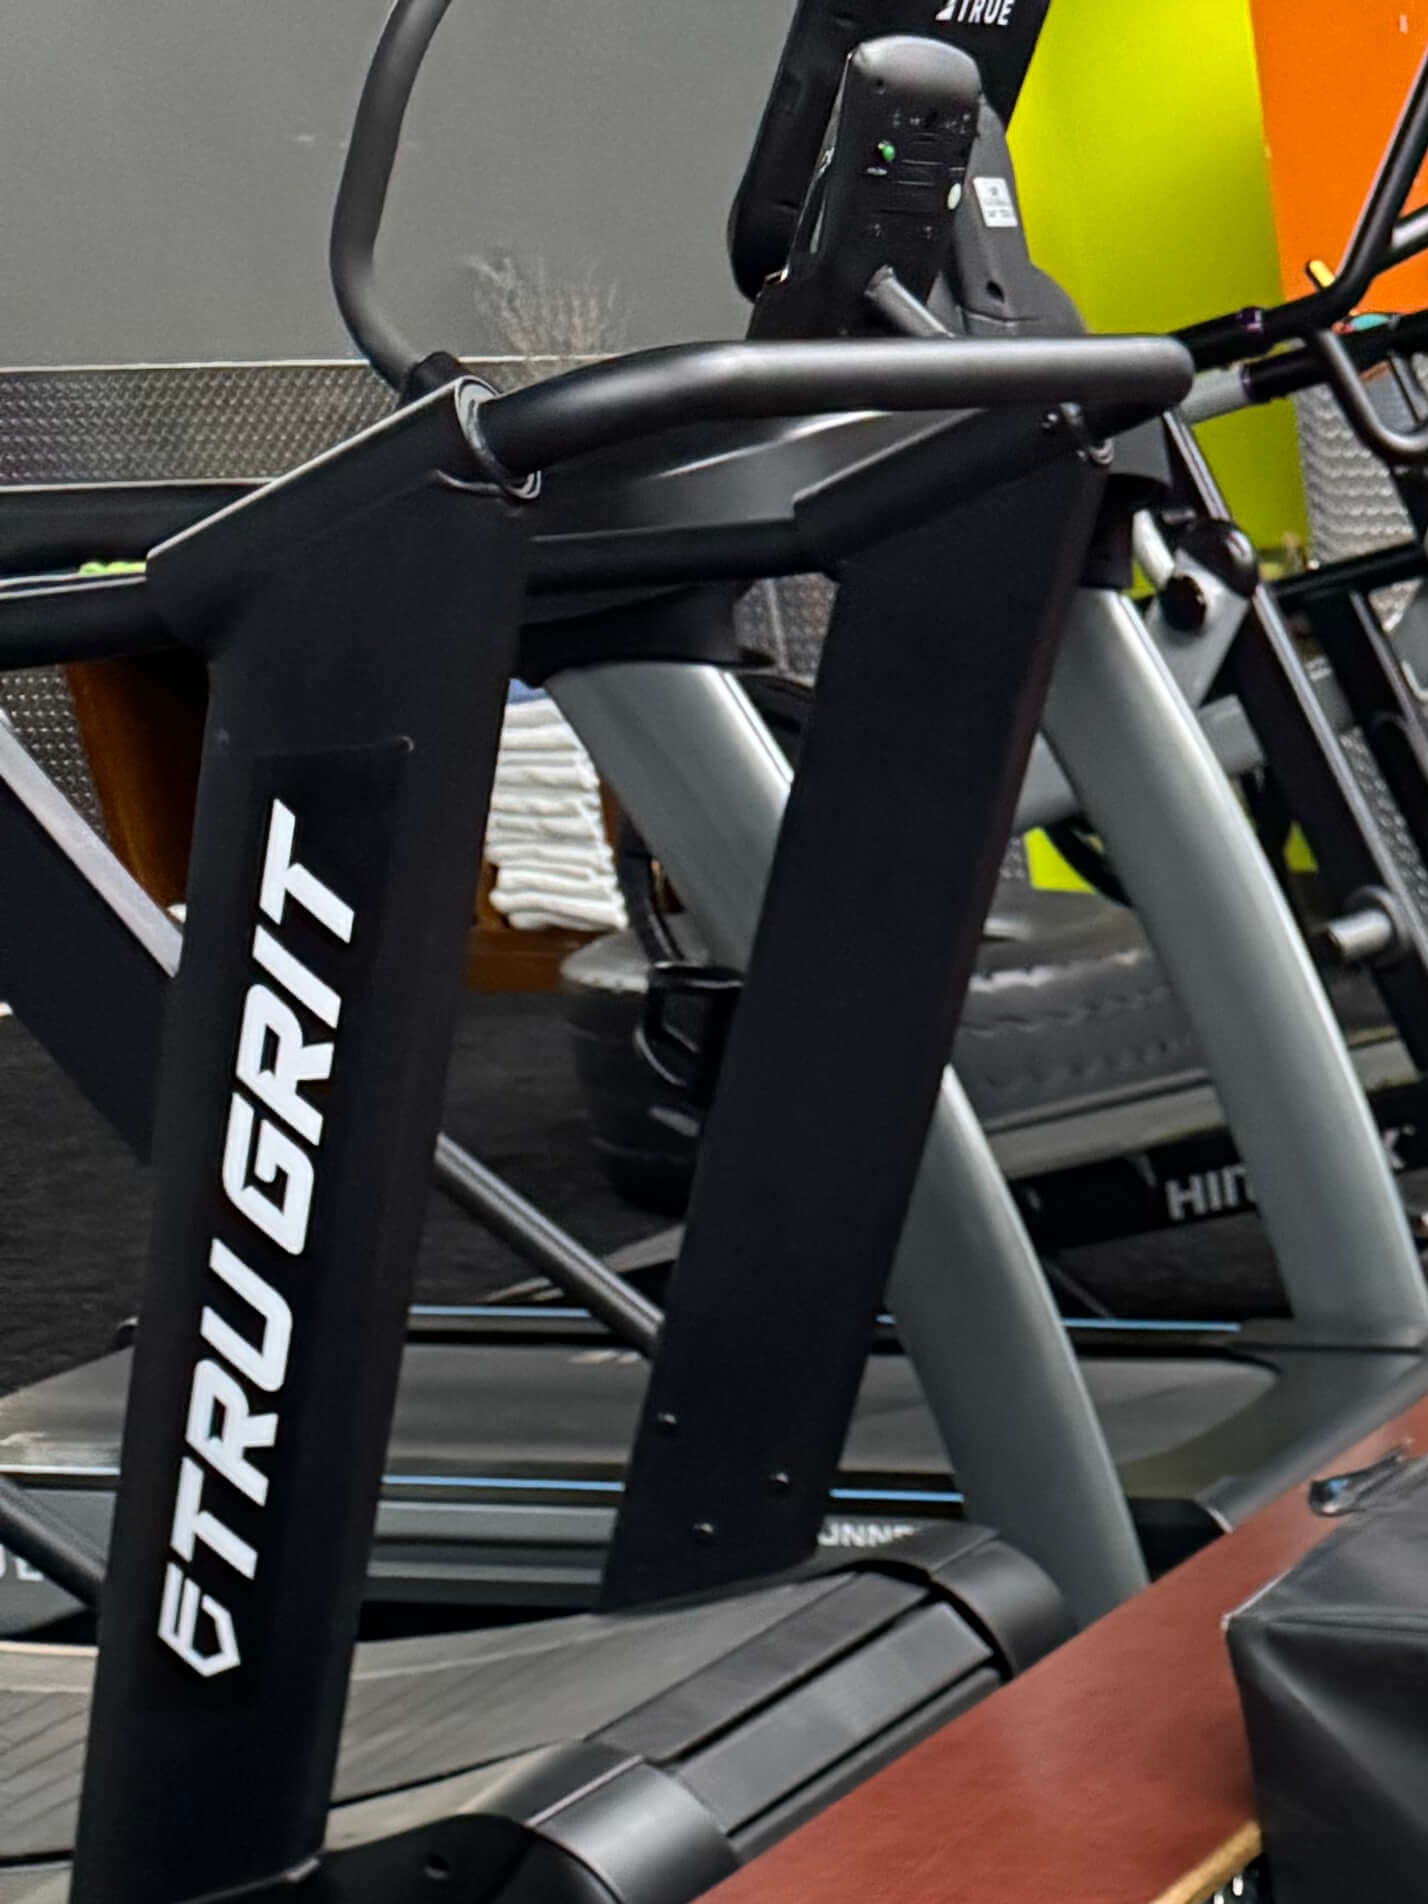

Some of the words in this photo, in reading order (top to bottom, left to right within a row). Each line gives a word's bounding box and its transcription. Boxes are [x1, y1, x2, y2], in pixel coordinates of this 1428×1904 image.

[957, 0, 1015, 26] TRUE
[222, 799, 355, 1256] GRIT
[169, 1237, 294, 1580] TRU
